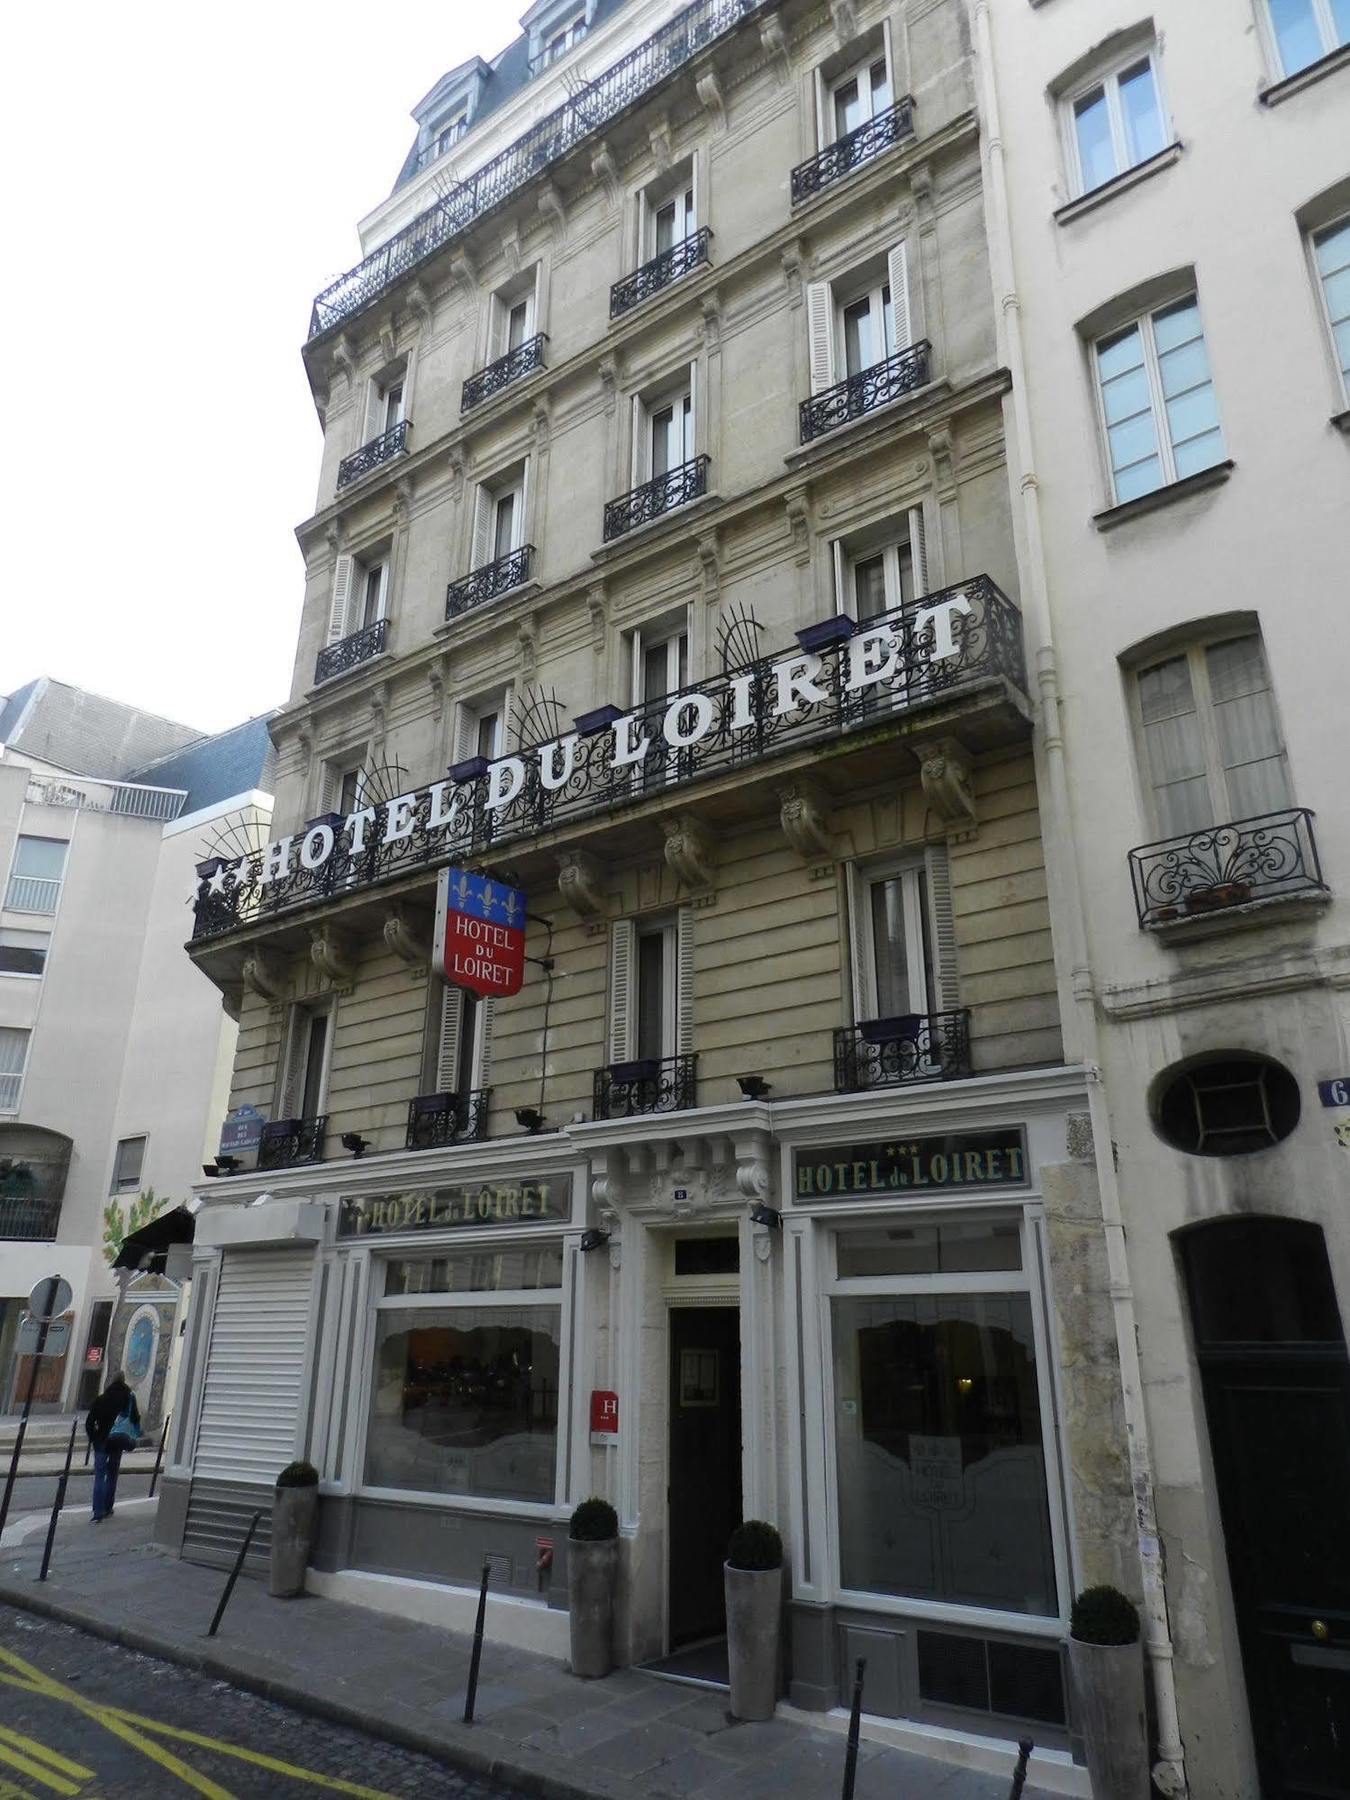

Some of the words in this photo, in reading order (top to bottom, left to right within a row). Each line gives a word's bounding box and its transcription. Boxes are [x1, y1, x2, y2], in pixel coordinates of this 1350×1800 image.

[262, 783, 461, 885] HOTEL
[484, 734, 580, 811] DU
[610, 595, 972, 769] LOIRET
[456, 915, 514, 950] HOTEL
[475, 944, 494, 959] DU
[454, 954, 513, 985] LOIRET
[1331, 1080, 1348, 1104] 6
[798, 1159, 885, 1193] HOTEL
[889, 1166, 908, 1187] du
[912, 1147, 1023, 1184] LOIRET
[372, 1196, 441, 1228] HOTEL
[463, 1185, 550, 1219] LOIRET
[604, 1400, 617, 1413] H
